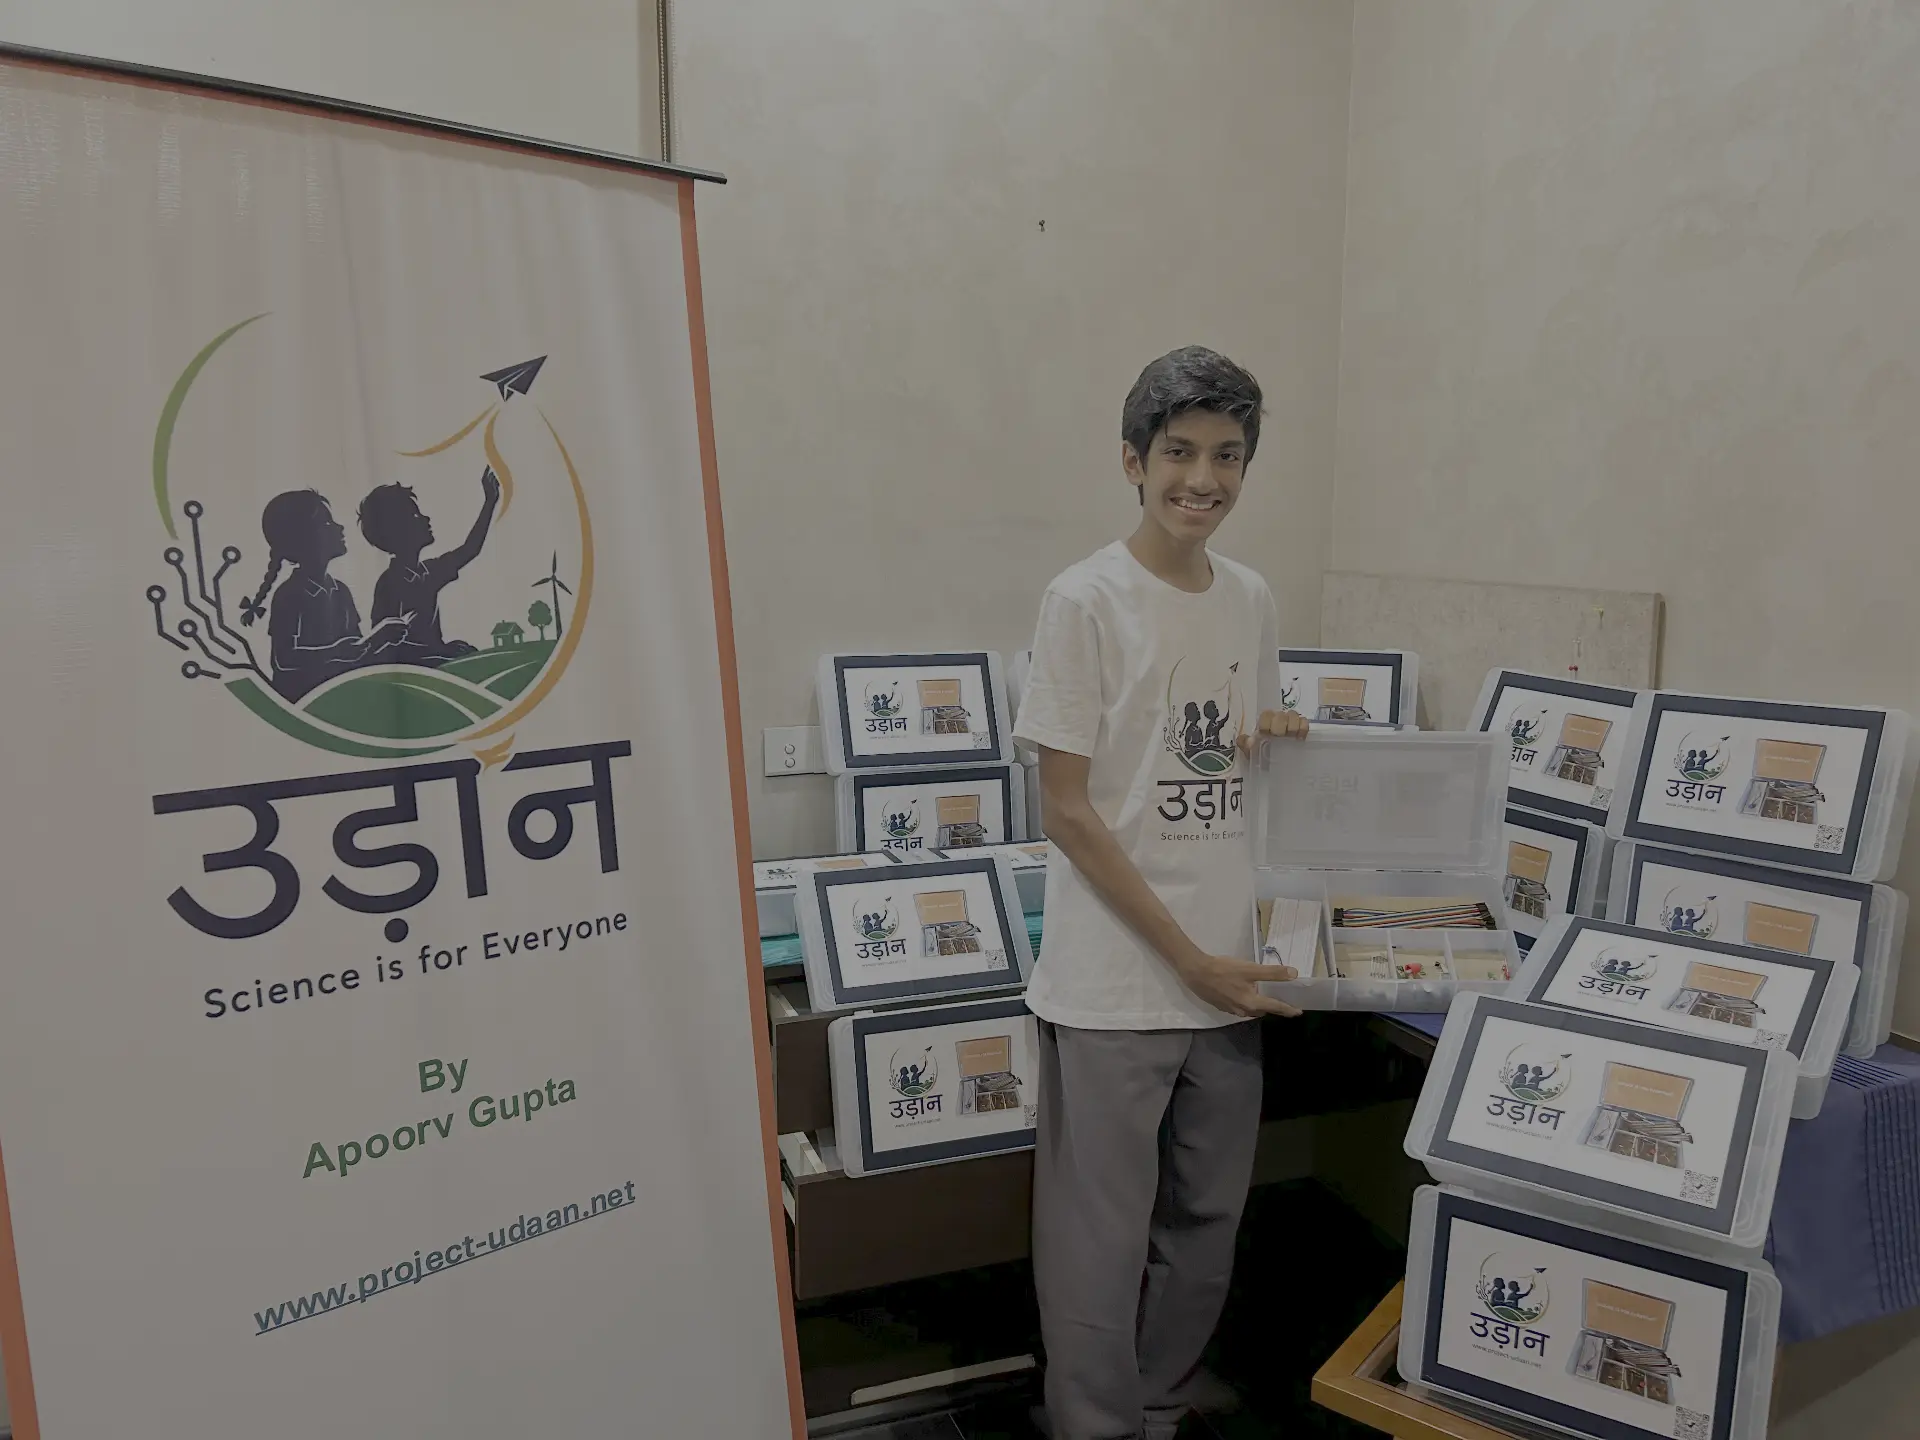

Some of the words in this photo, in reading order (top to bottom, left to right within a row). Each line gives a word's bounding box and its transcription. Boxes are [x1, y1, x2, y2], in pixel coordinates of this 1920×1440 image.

[865, 717, 907, 735] उड़ान
[1665, 779, 1727, 805] उड़ान
[152, 740, 632, 943] उड़ान
[1161, 831, 1199, 841] Science
[1202, 831, 1209, 841] is
[204, 965, 361, 1018] Science
[377, 956, 404, 983] is
[419, 944, 469, 975] for
[483, 911, 628, 960] Everyone
[855, 939, 907, 960] उड़ान
[1578, 974, 1650, 1001] उड़ान
[419, 1057, 469, 1092] By
[889, 1093, 943, 1120] उड़ान
[1486, 1094, 1566, 1131] उड़ान
[302, 1109, 456, 1179] Apoorv
[468, 1075, 577, 1135] Gupta
[254, 1180, 637, 1336] www.project-udaan.net
[1470, 1311, 1550, 1357] उड़ान
